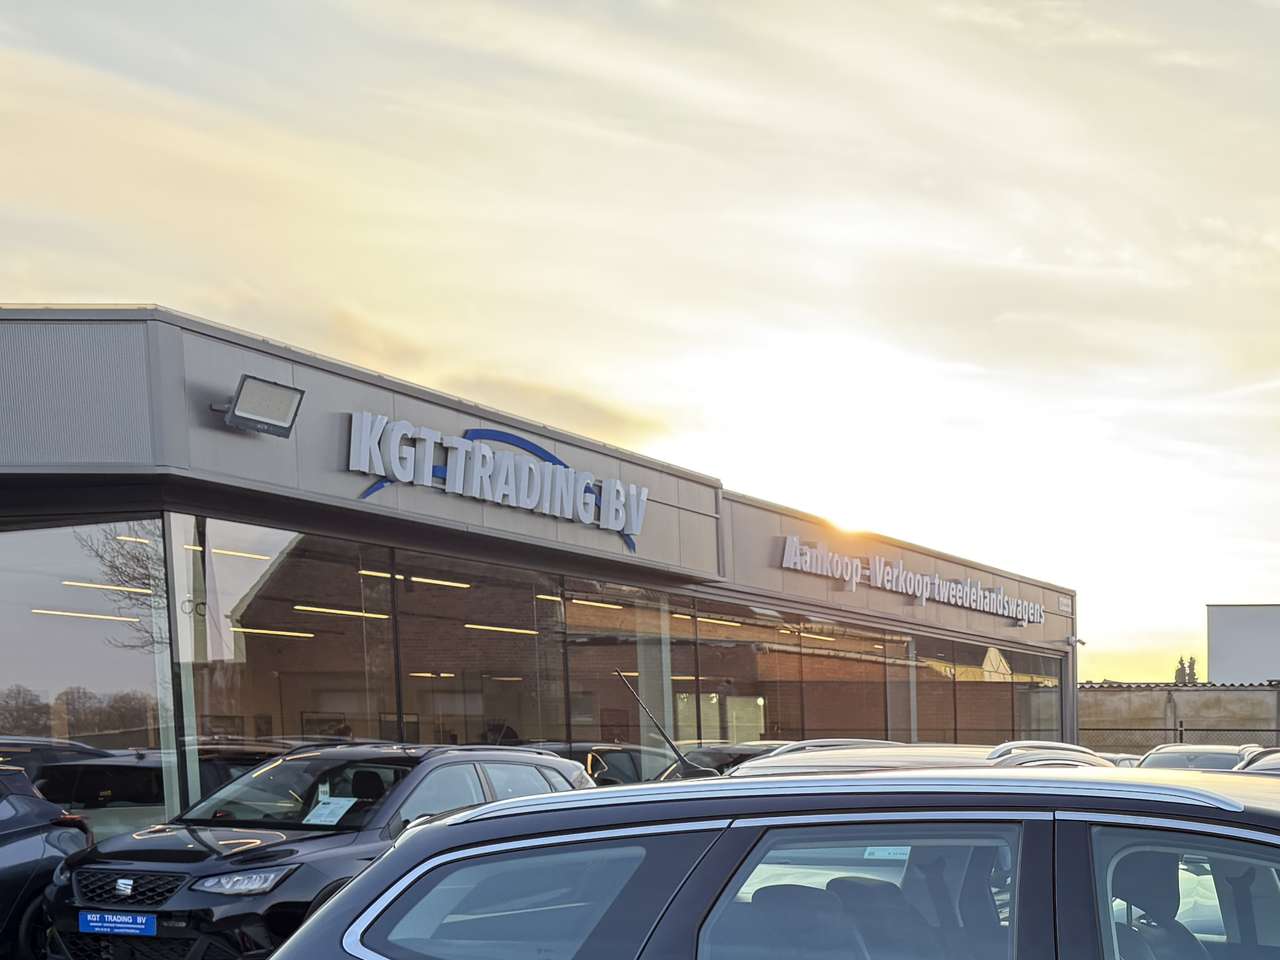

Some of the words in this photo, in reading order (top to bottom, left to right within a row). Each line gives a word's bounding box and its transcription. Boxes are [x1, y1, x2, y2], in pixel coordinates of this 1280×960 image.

[350, 411, 441, 487] KGT
[440, 434, 598, 525] TRADING
[599, 477, 649, 535] BV
[783, 535, 862, 592] Aankoop
[869, 554, 931, 606] Verkoop
[934, 573, 1046, 627] tweedehandswagens
[104, 914, 133, 923] TRADING
[136, 916, 146, 924] BV
